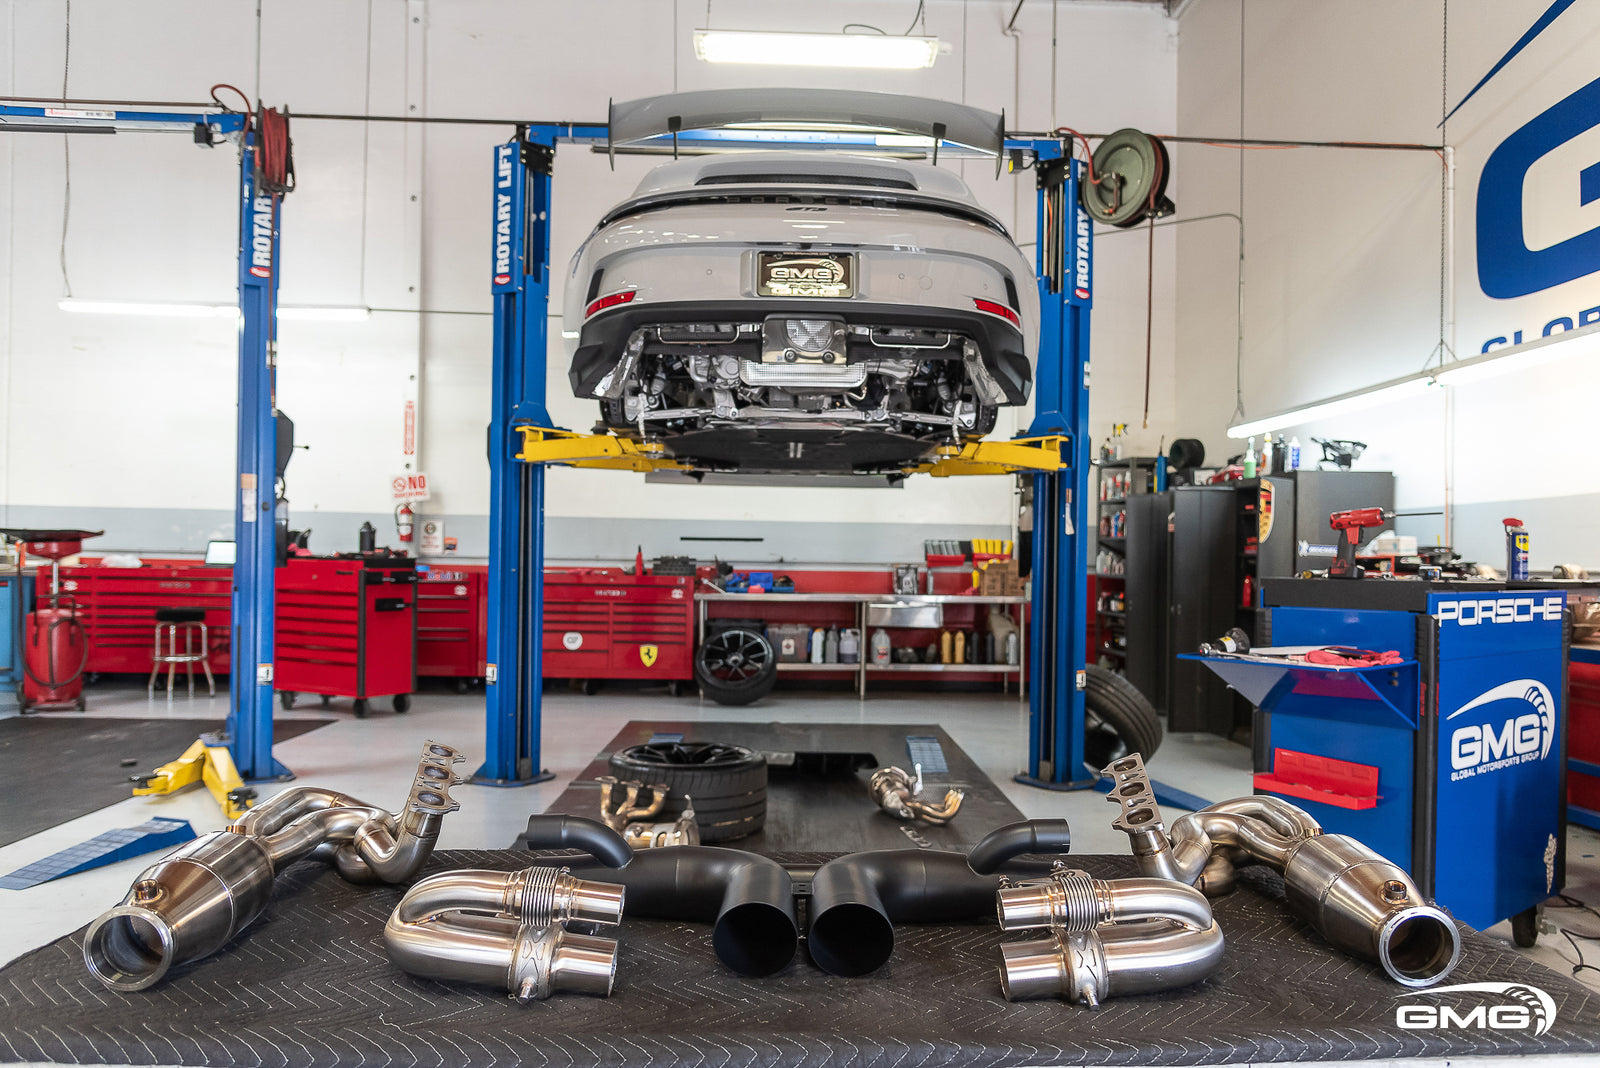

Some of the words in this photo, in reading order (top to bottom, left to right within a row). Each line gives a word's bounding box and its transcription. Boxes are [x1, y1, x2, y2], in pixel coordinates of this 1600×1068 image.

[498, 146, 512, 189] LIFT
[252, 193, 272, 267] ROTAR
[496, 194, 511, 274] ROTARY
[1076, 208, 1089, 289] ROTARY
[770, 267, 833, 279] GMG
[408, 475, 426, 490] NO
[1438, 597, 1562, 628] PORSCHE
[1451, 714, 1541, 771] GMG
[1450, 766, 1476, 782] GLOBAL
[1476, 755, 1520, 775] MOTORSPORTS
[1520, 750, 1540, 764] GROUP
